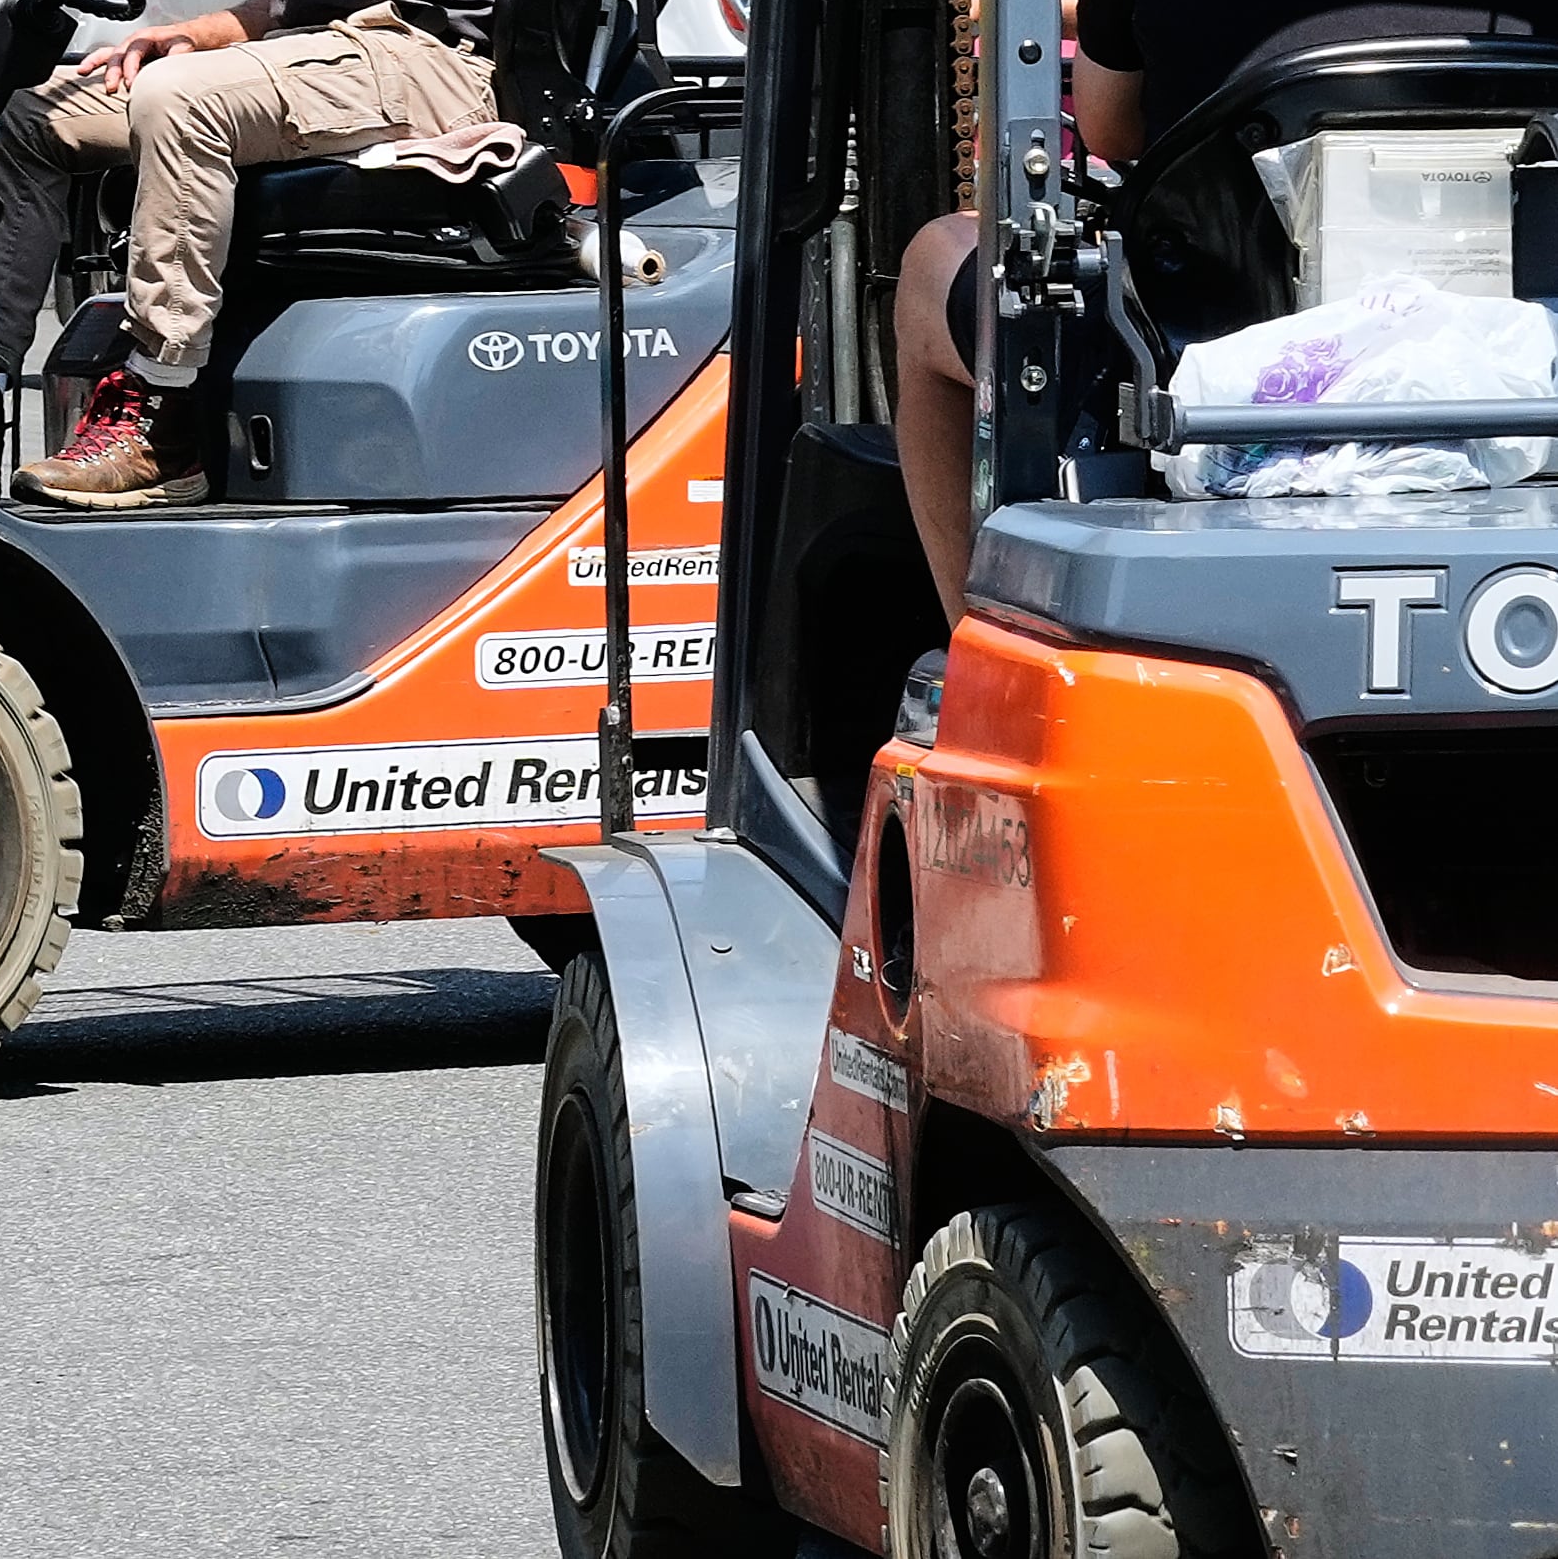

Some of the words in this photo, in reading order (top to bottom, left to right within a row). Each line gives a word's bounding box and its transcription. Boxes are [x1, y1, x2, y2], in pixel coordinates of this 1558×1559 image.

[1421, 172, 1472, 182] TOYOTA
[527, 328, 679, 363] TOYTA
[303, 761, 491, 815] United
[507, 757, 707, 805] Renals
[1386, 1260, 1555, 1300] United
[1384, 1303, 1558, 1343] Rentals
[777, 1307, 829, 1396] United
[830, 1333, 884, 1420] Rental
